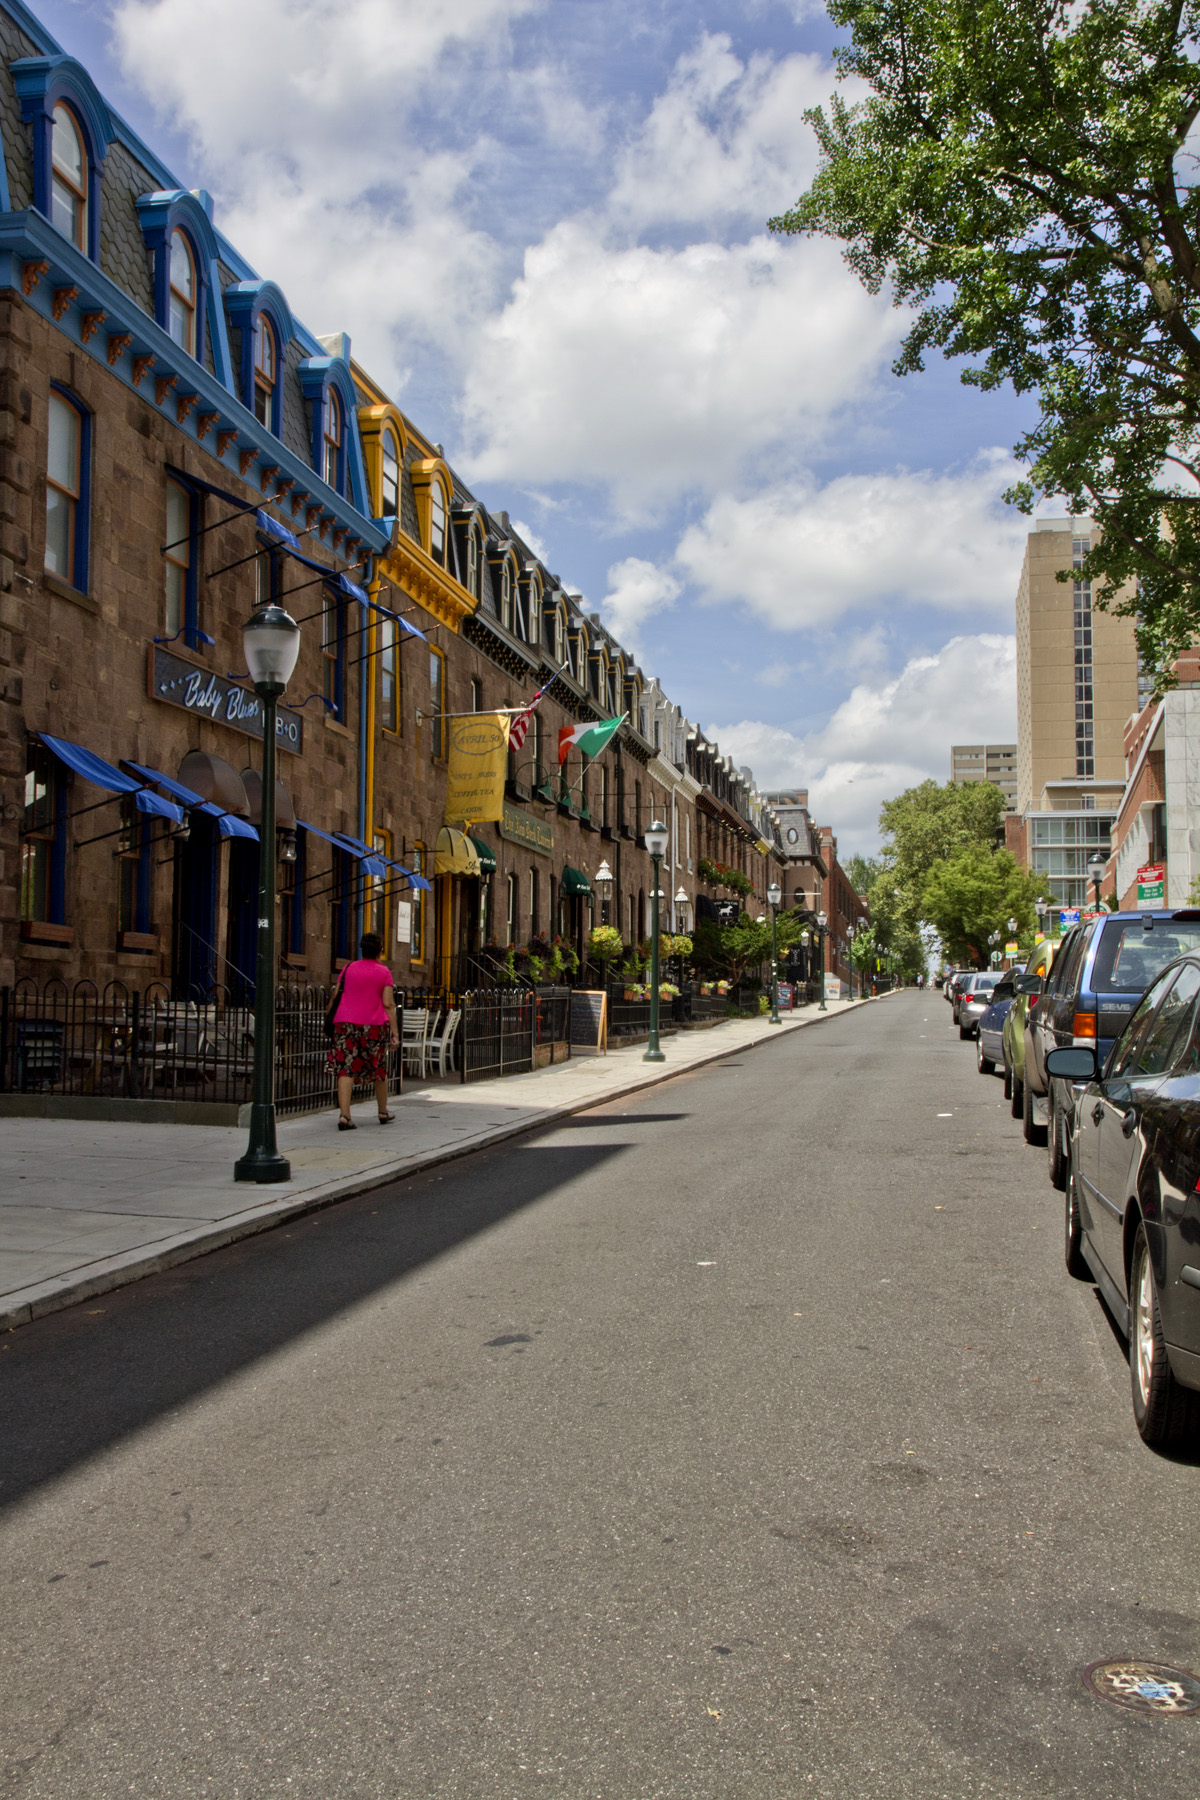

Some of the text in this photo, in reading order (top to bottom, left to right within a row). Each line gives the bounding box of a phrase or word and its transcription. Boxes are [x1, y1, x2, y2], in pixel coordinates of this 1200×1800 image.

[184, 670, 222, 718] Baby
[225, 687, 259, 720] Blues
[457, 734, 500, 745] AVRIL 50
[480, 788, 495, 796] TEA
